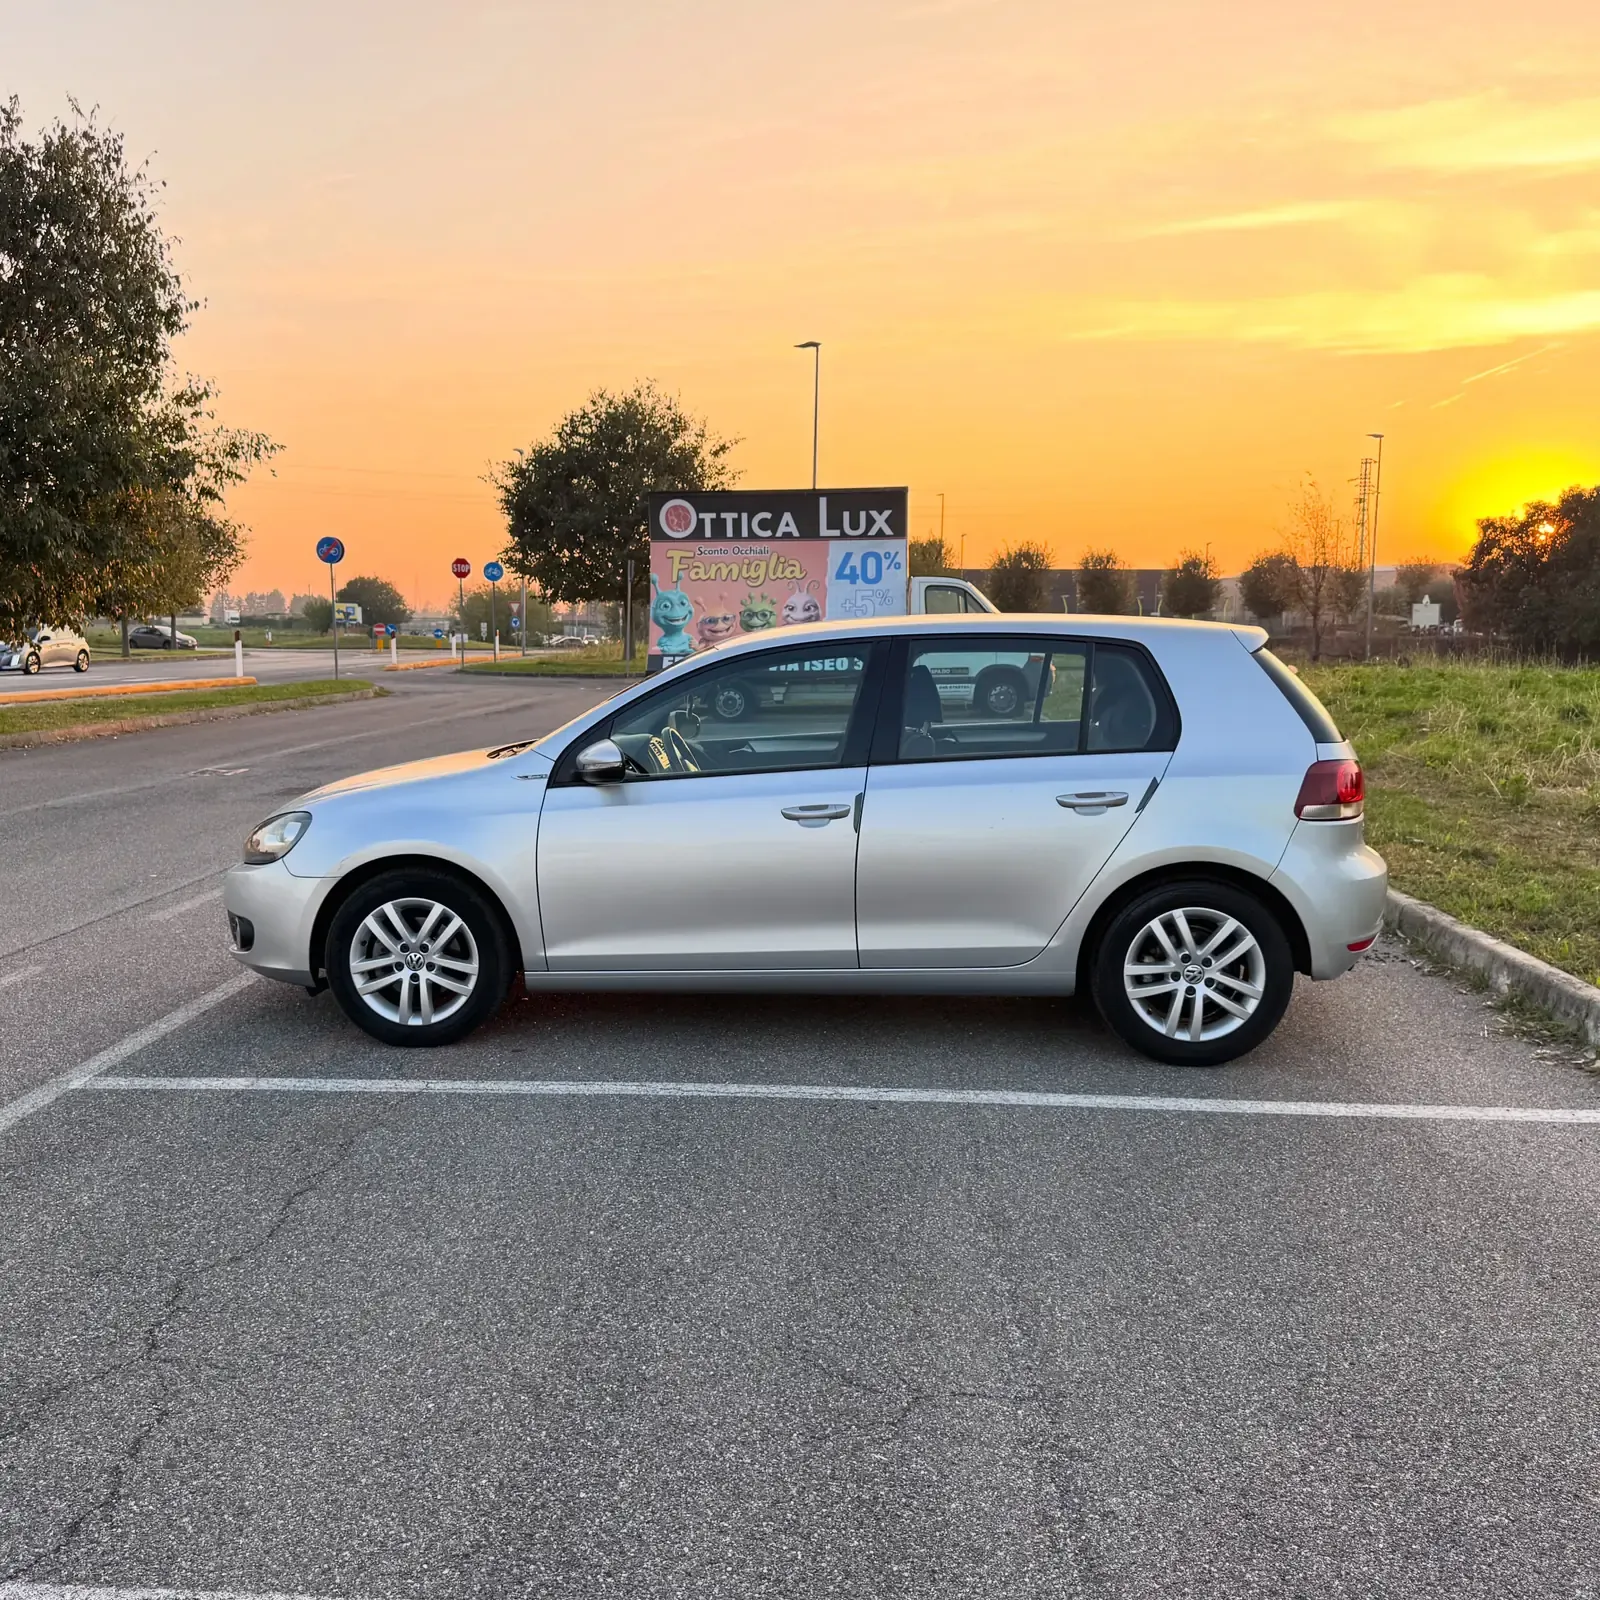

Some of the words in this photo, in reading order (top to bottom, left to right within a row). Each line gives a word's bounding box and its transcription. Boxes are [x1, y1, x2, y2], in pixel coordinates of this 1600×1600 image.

[697, 546, 729, 556] Sconto
[732, 545, 769, 556] Occhiali
[453, 563, 469, 572] STOP
[666, 549, 807, 588] Famiglia
[835, 551, 901, 585] 40%
[841, 588, 893, 617] +5%
[804, 657, 849, 671] ISEO
